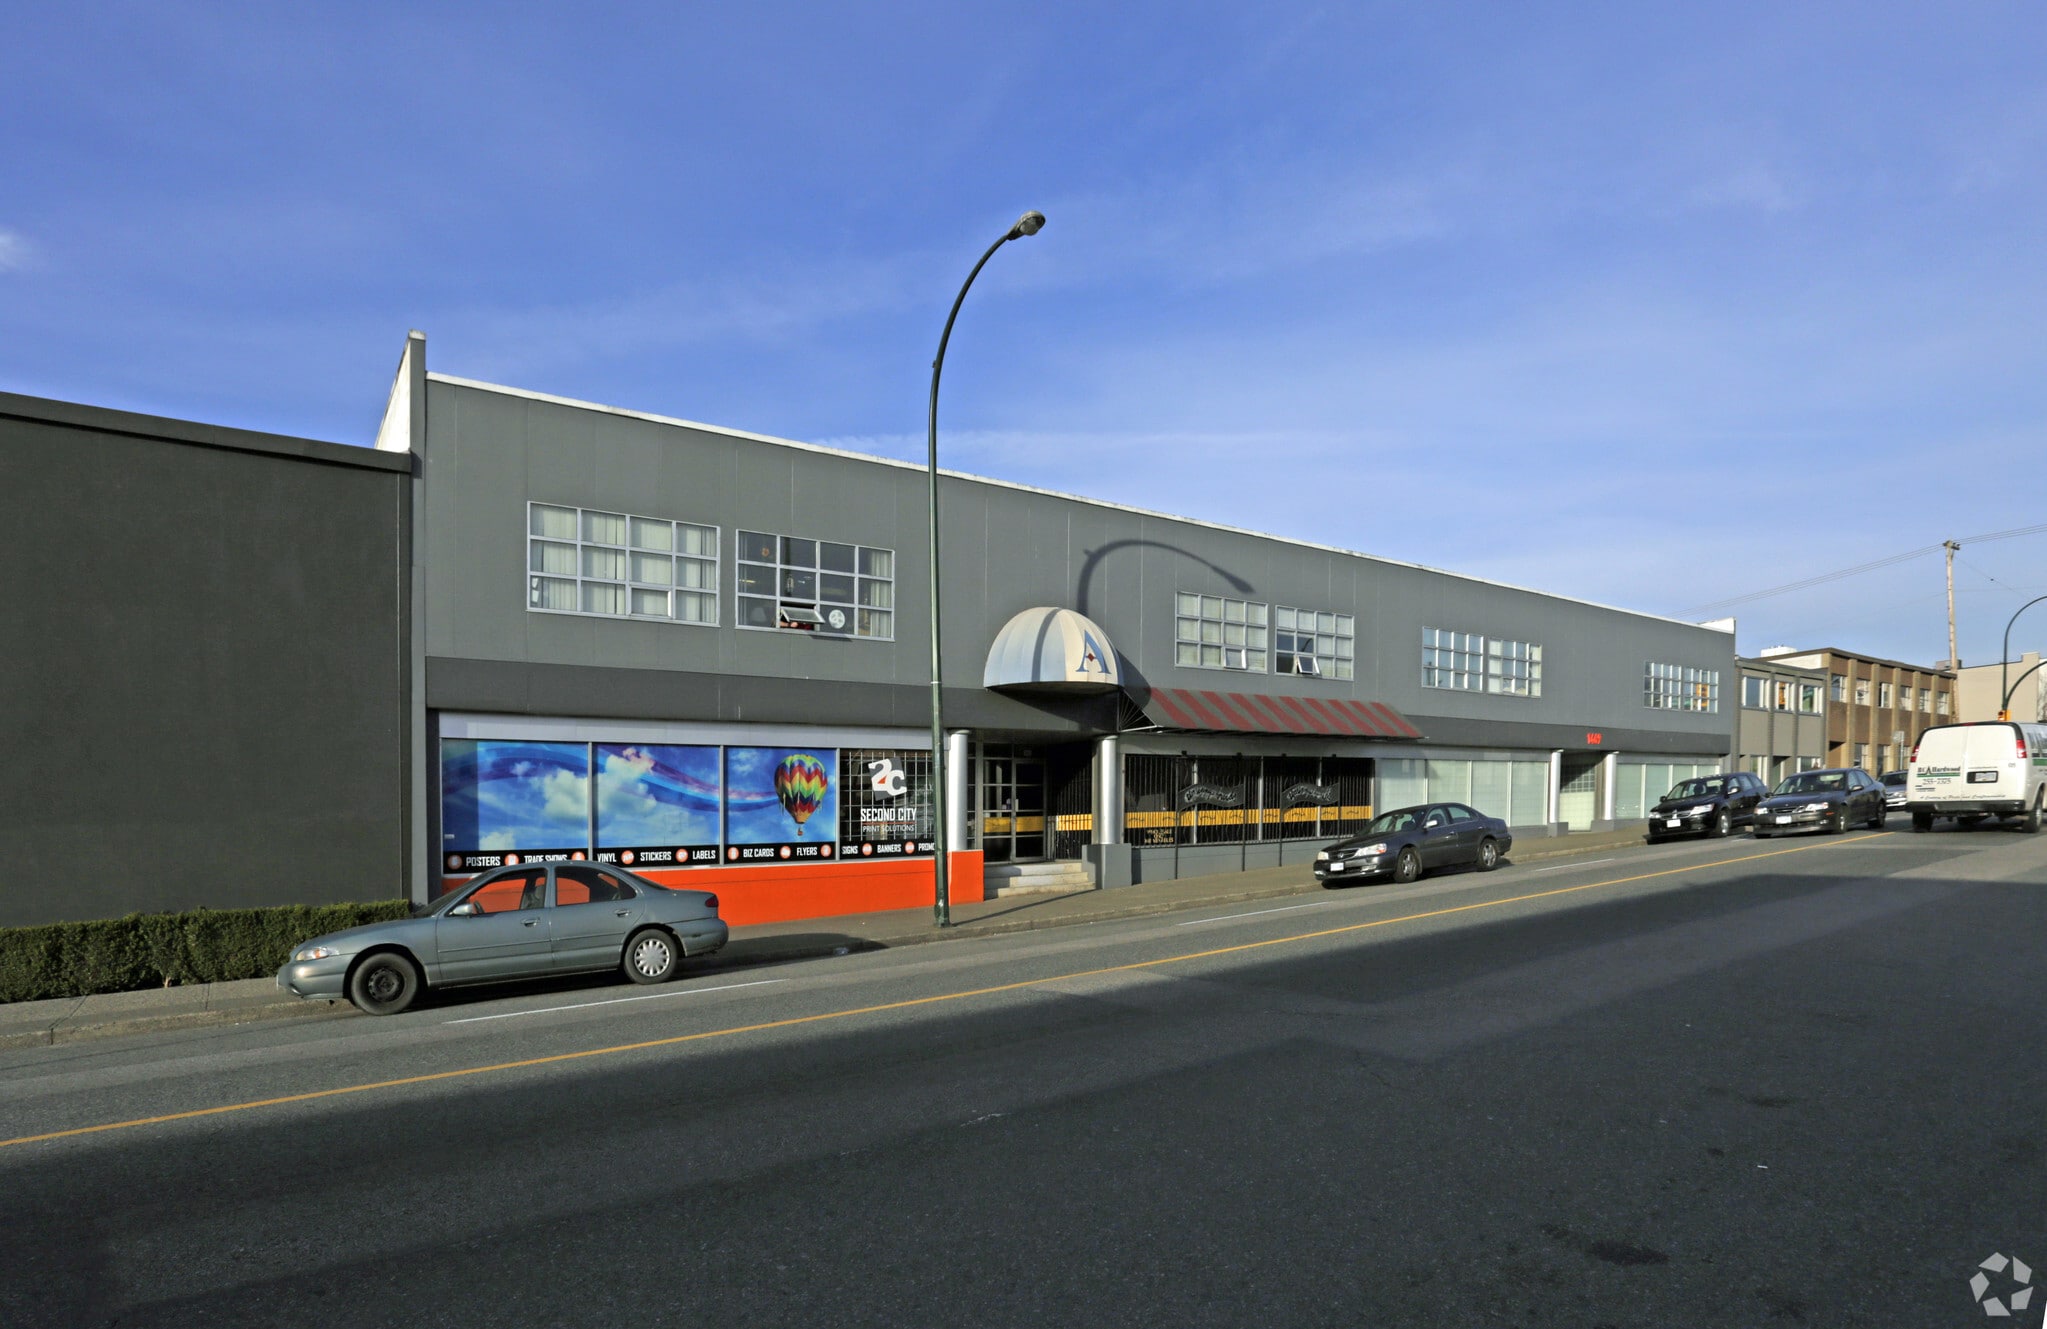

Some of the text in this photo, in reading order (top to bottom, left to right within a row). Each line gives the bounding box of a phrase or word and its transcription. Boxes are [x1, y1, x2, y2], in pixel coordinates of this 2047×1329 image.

[1075, 630, 1113, 675] A
[860, 807, 917, 822] SECOND CITY
[881, 824, 915, 832] SOLUTIONS
[743, 848, 775, 858] BIZ CARDS
[796, 847, 818, 856] FLYERS
[842, 845, 858, 855] SIGNS
[877, 843, 902, 853] BANNERS
[597, 853, 617, 863] VINYL
[640, 851, 672, 862] STICKERS
[692, 850, 716, 860] LABELS
[466, 855, 501, 867] POSTERS
